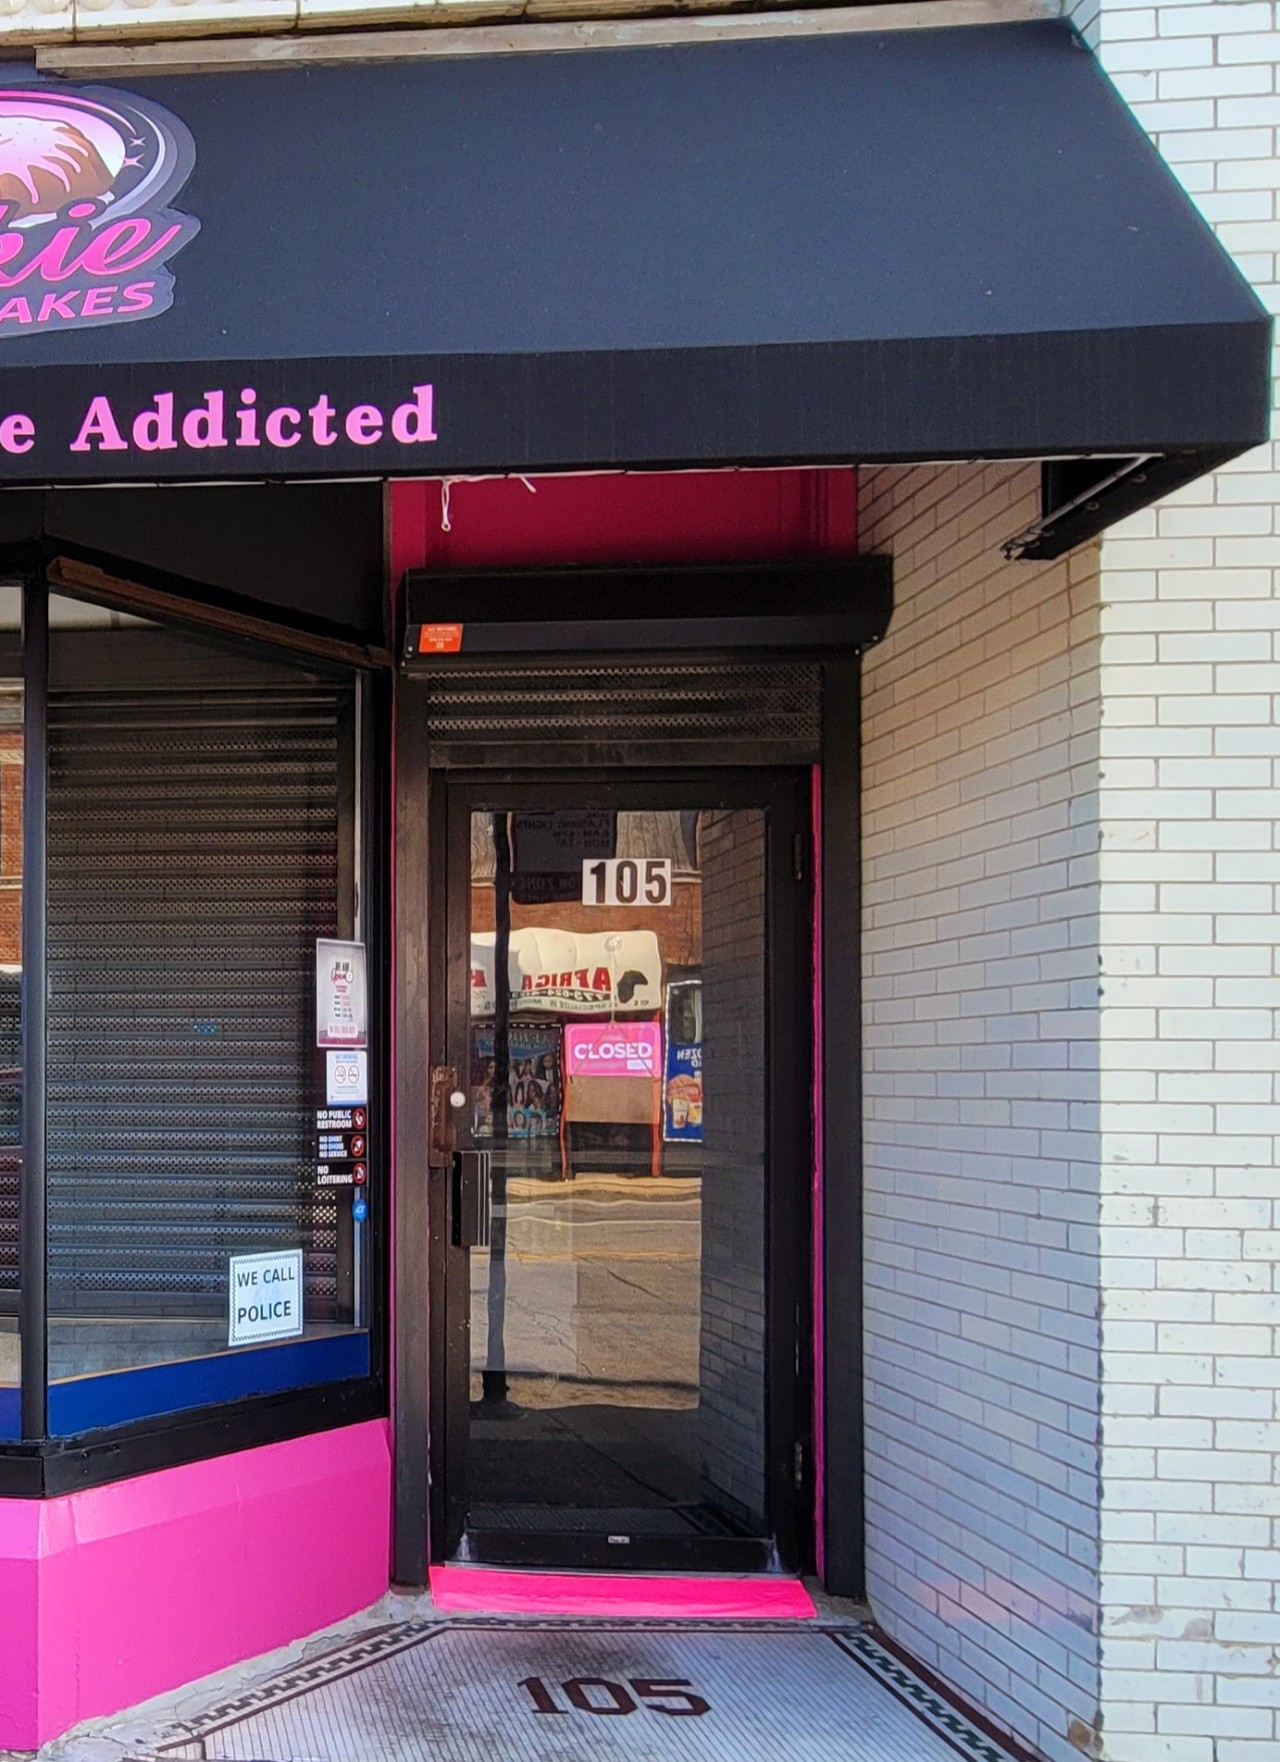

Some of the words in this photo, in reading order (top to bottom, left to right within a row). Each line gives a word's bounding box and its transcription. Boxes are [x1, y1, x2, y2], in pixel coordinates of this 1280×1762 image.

[69, 384, 438, 452] Addicted
[589, 860, 667, 905] 105
[573, 1042, 653, 1060] CLOSED
[317, 1110, 327, 1119] NO
[328, 1110, 351, 1119] PUBLIC
[317, 1120, 352, 1129] RESTROOM
[317, 1165, 329, 1174] NO
[317, 1174, 353, 1185] LOITERING
[237, 1271, 258, 1288] WE
[263, 1267, 295, 1284] CALL
[237, 1300, 292, 1324] POLICE
[516, 1676, 711, 1717] 105
